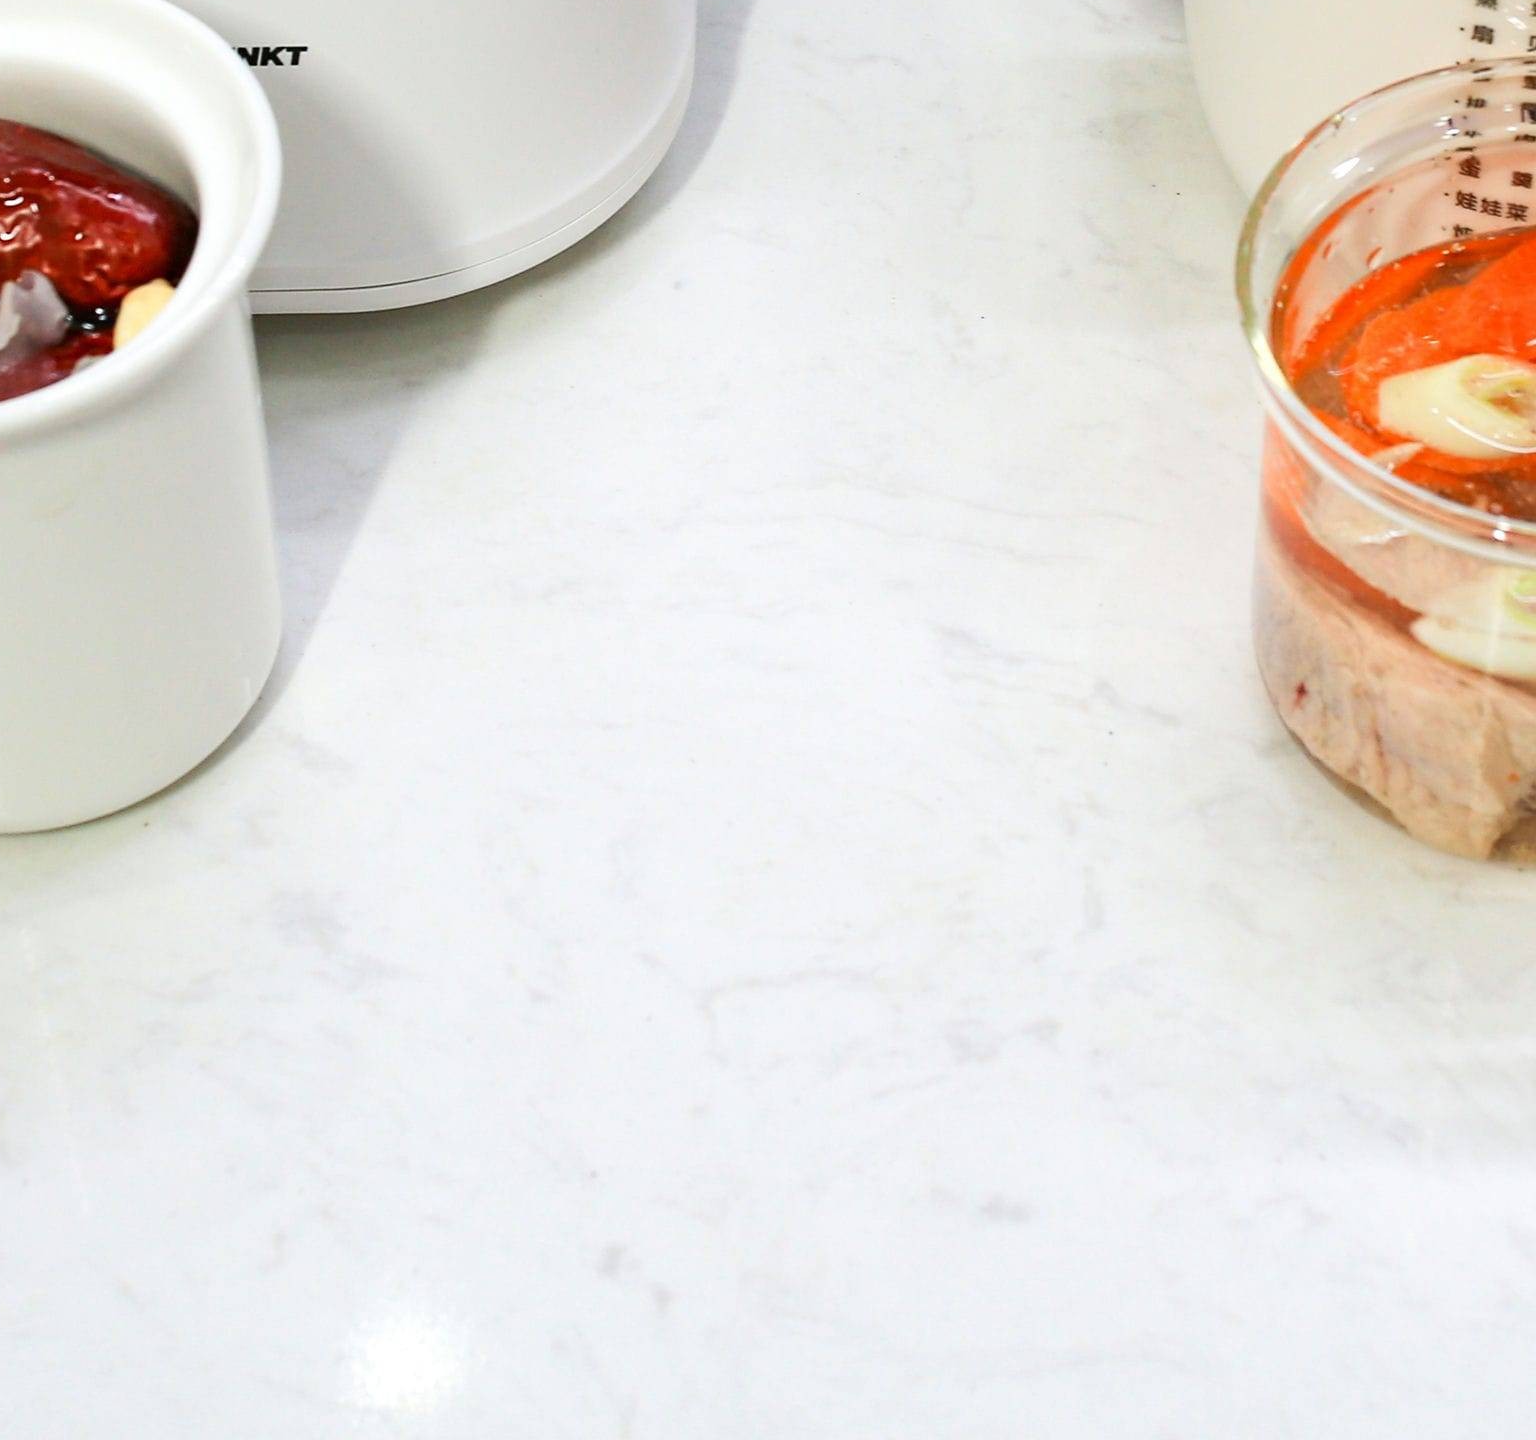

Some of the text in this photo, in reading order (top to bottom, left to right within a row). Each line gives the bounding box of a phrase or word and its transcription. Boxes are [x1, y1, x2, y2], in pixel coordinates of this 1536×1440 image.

[232, 46, 308, 67] NKT
[1455, 189, 1530, 224] 娃娃菜
